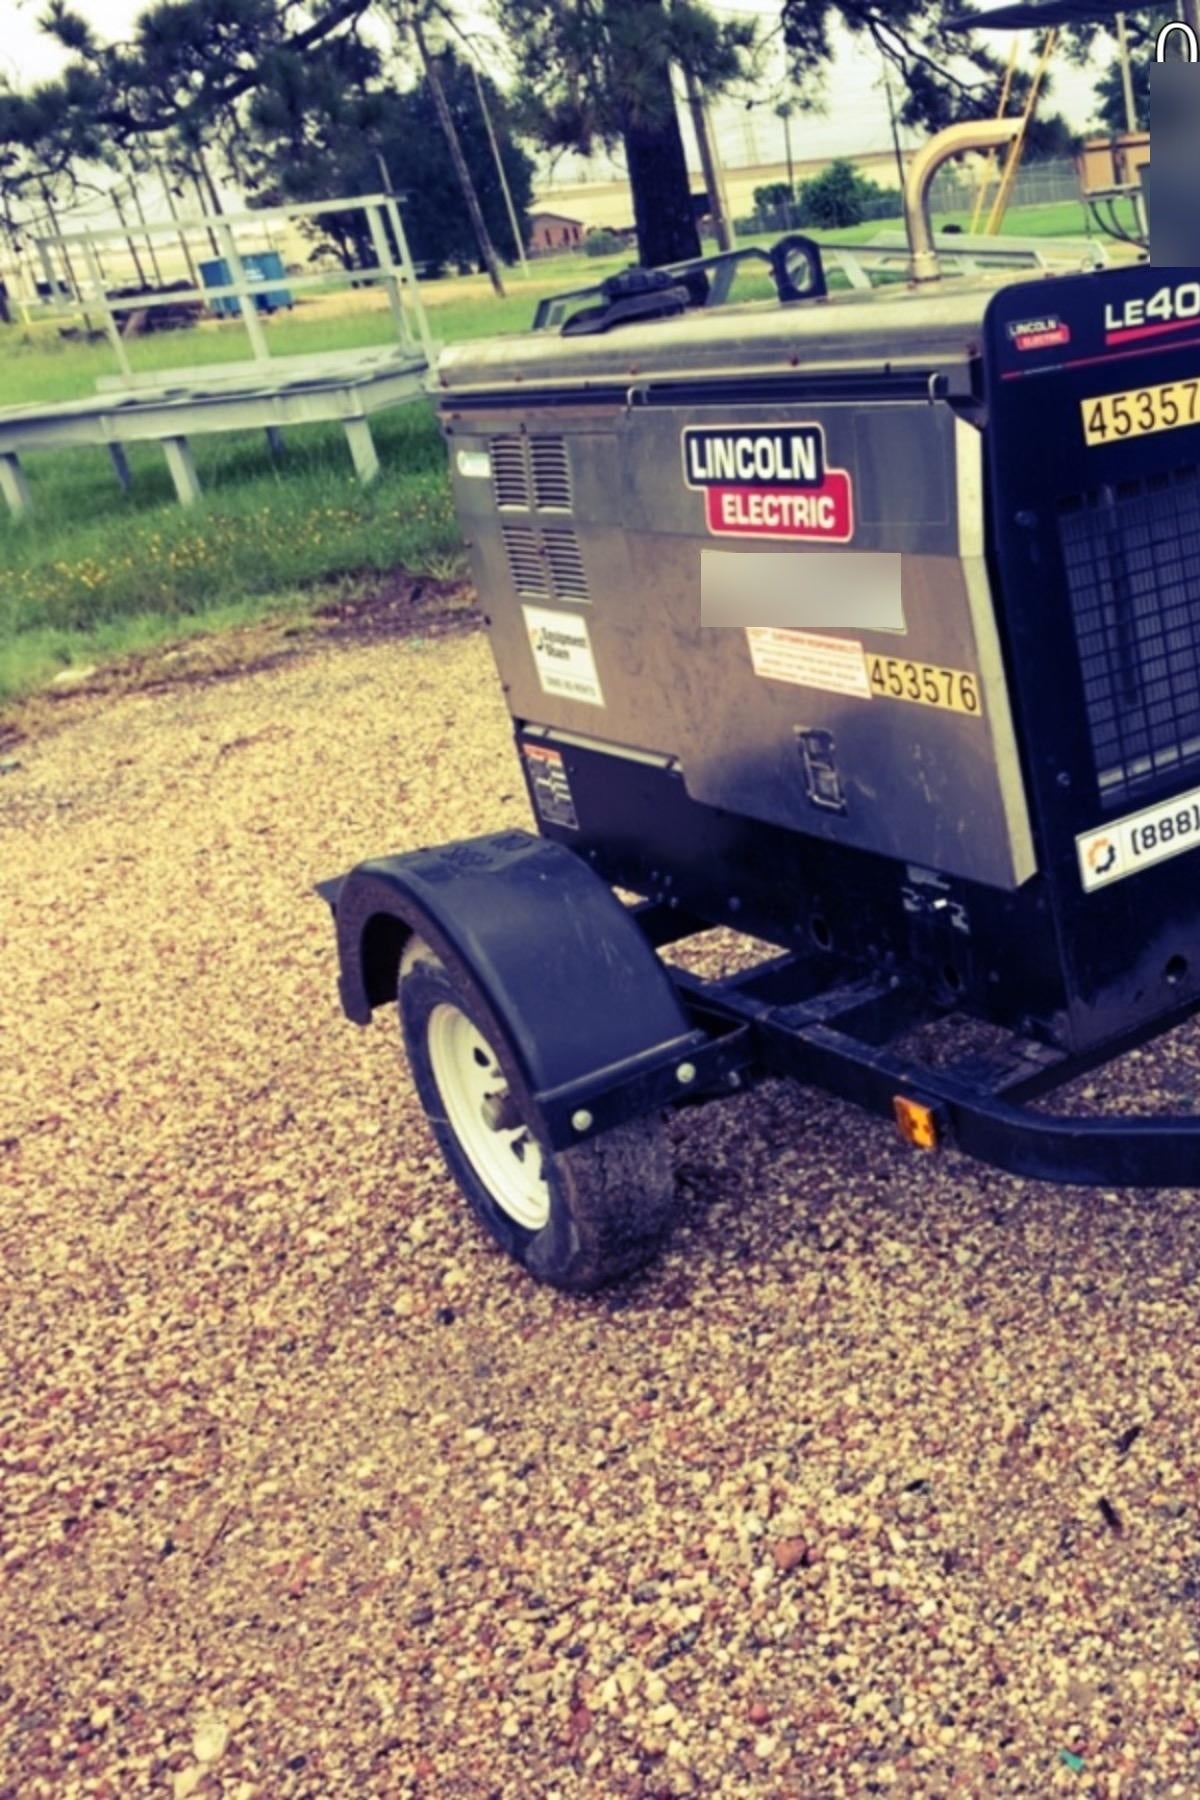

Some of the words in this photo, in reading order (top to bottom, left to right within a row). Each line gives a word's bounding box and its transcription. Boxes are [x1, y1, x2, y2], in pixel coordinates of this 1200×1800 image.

[689, 436, 817, 480] LINCOLN
[720, 493, 836, 528] ELECTRIC
[870, 658, 977, 712] 453576
[1130, 804, 1200, 856] (888)
